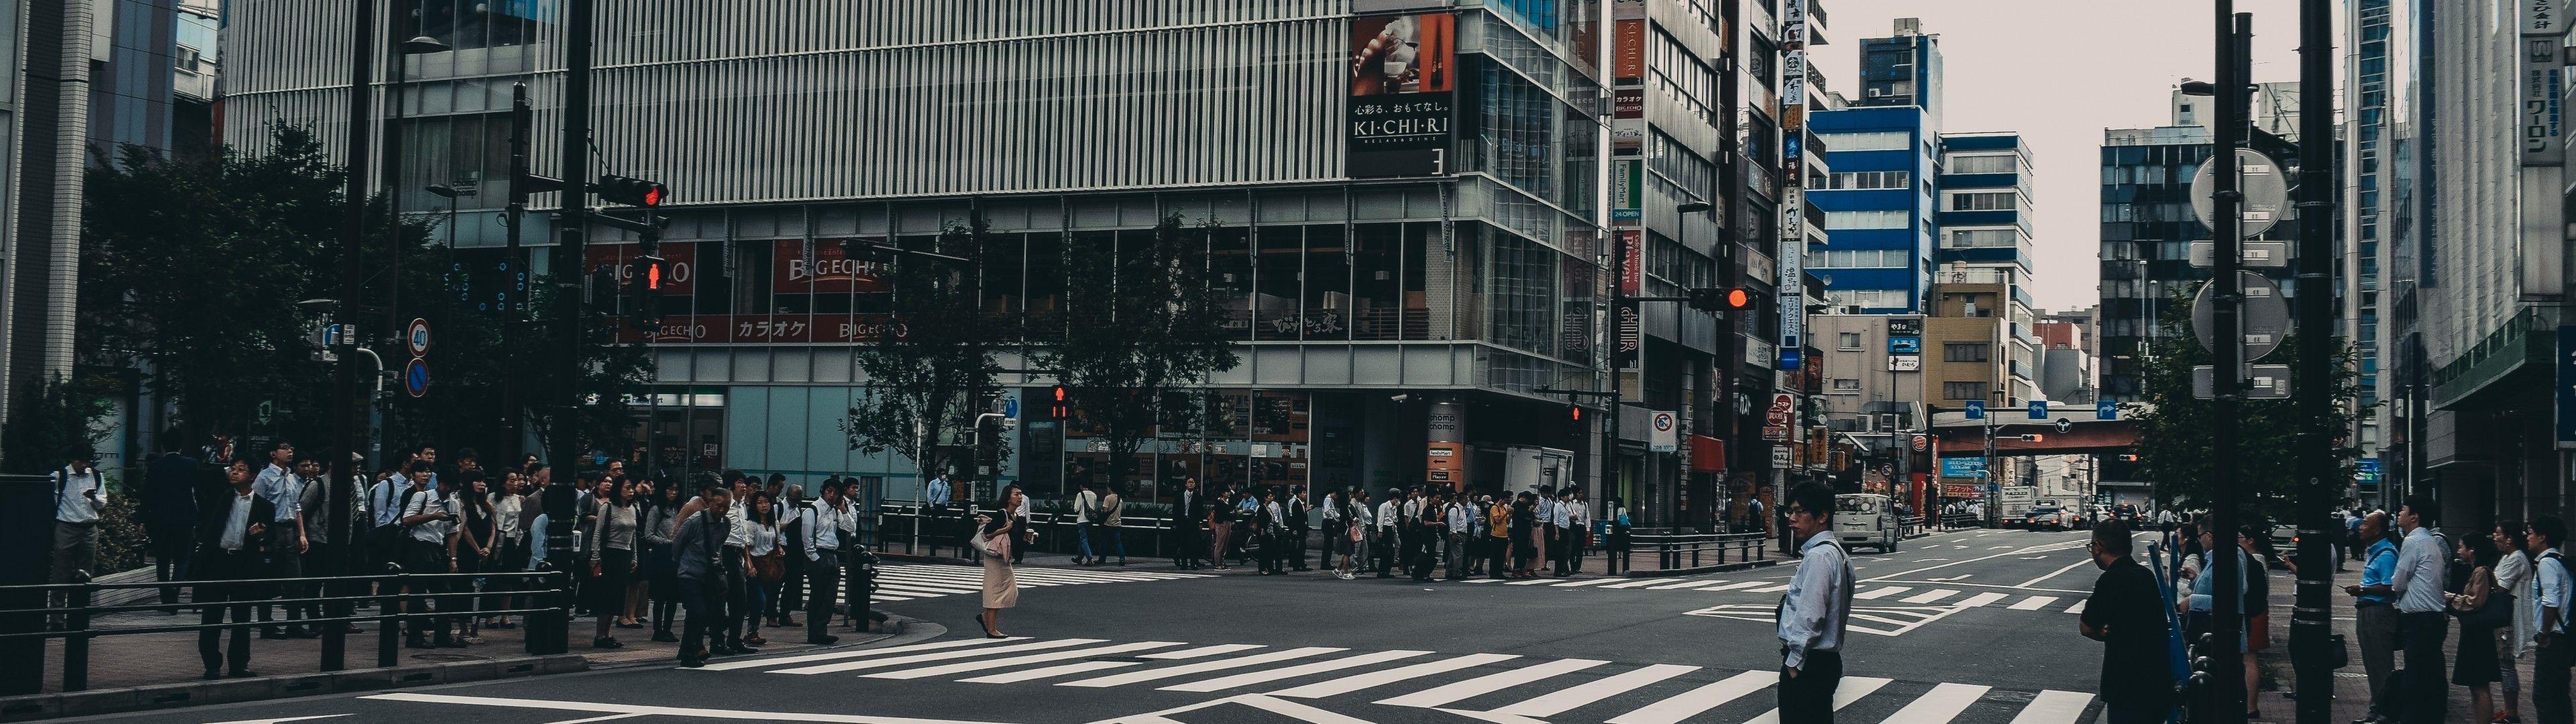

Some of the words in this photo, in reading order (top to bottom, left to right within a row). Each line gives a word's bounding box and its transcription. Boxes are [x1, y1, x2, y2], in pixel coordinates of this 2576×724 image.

[1354, 102, 1448, 115] 心彩る、おもてなし。
[2527, 100, 2546, 153] ワーロン
[739, 321, 806, 337] カラオケ
[869, 322, 908, 337] ECO
[414, 330, 426, 346] 40
[1429, 415, 1455, 424] chomp
[1429, 423, 1455, 432] chomp
